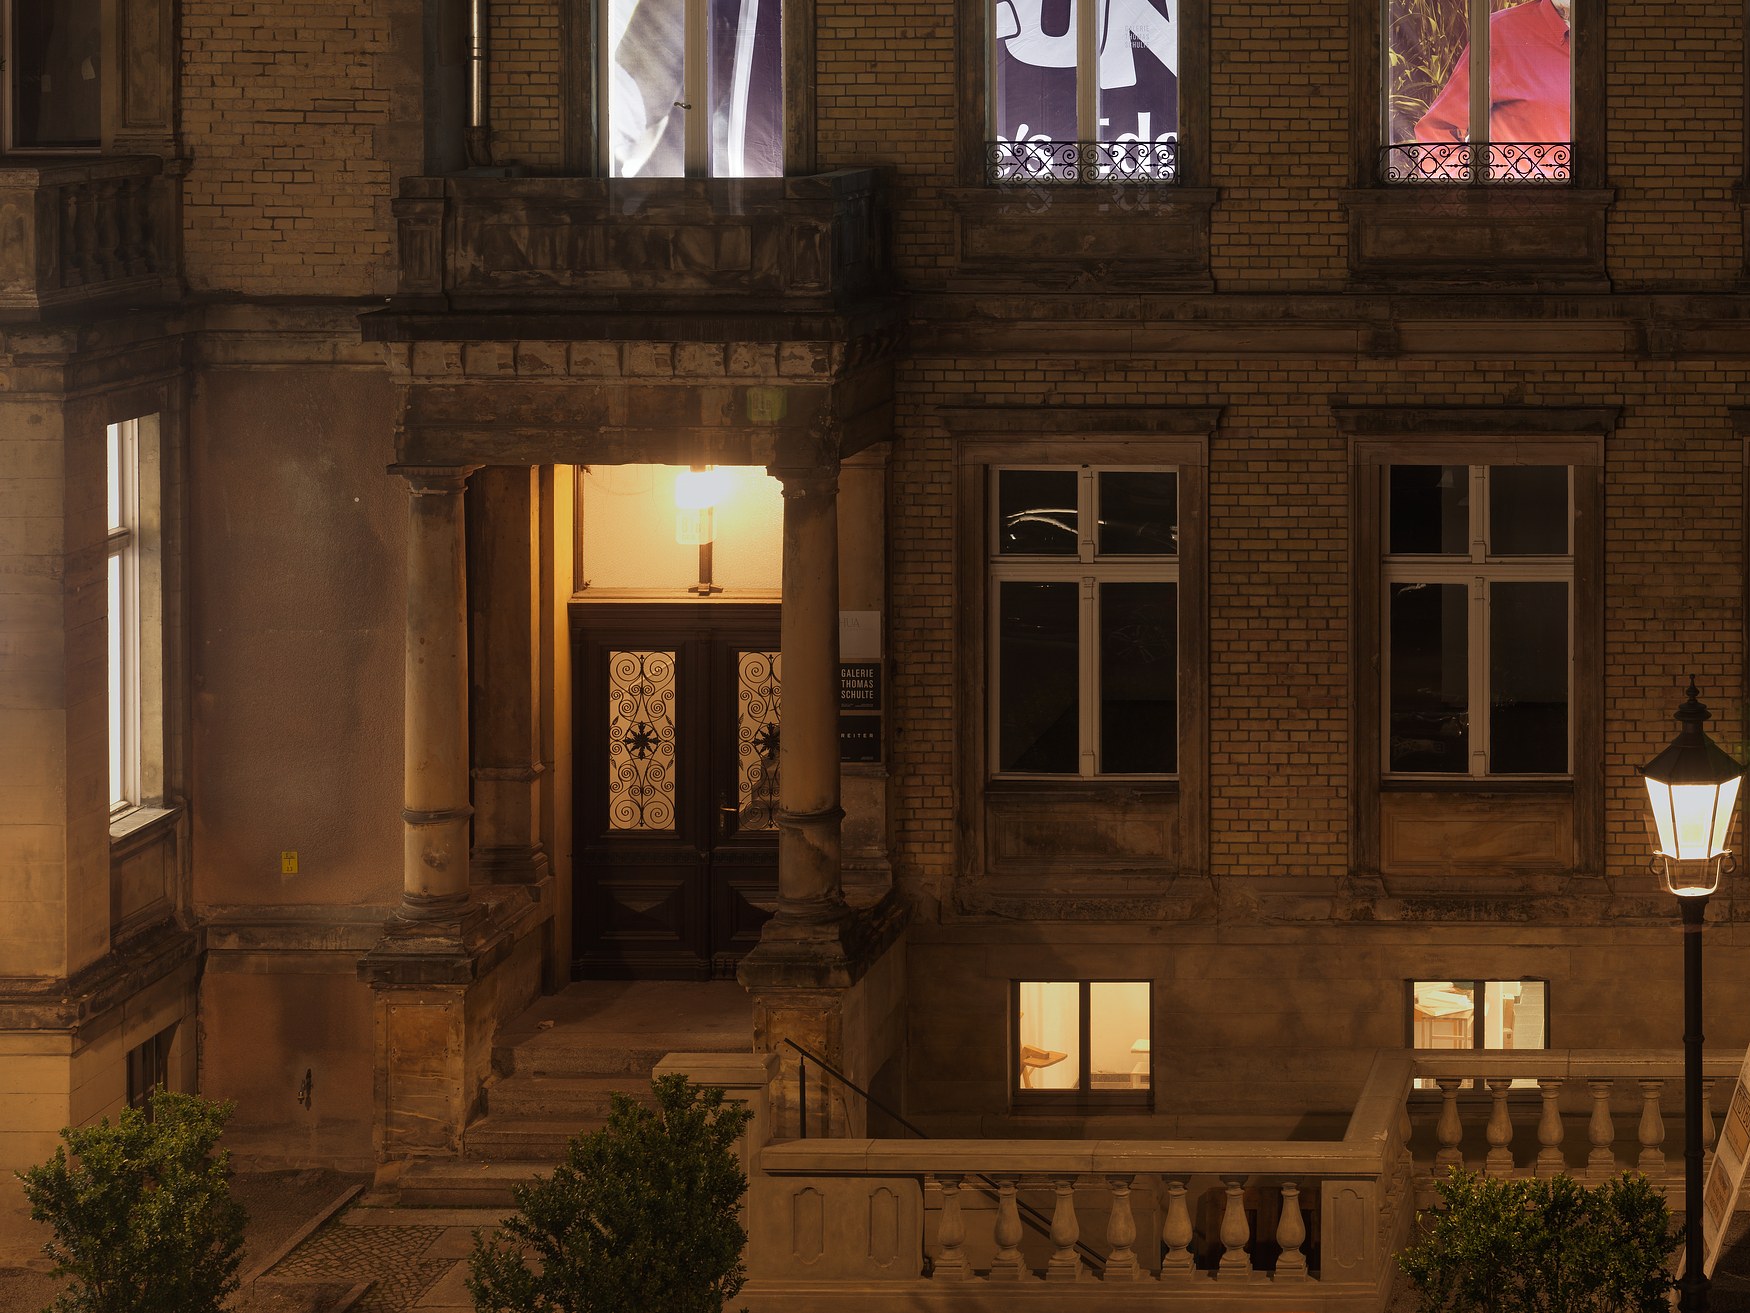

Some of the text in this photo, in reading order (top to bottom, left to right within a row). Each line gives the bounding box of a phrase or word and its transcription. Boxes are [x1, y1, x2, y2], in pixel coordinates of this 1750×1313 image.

[841, 669, 874, 678] GALERIE
[841, 679, 874, 688] THOMAS
[841, 690, 874, 699] SCHULTE
